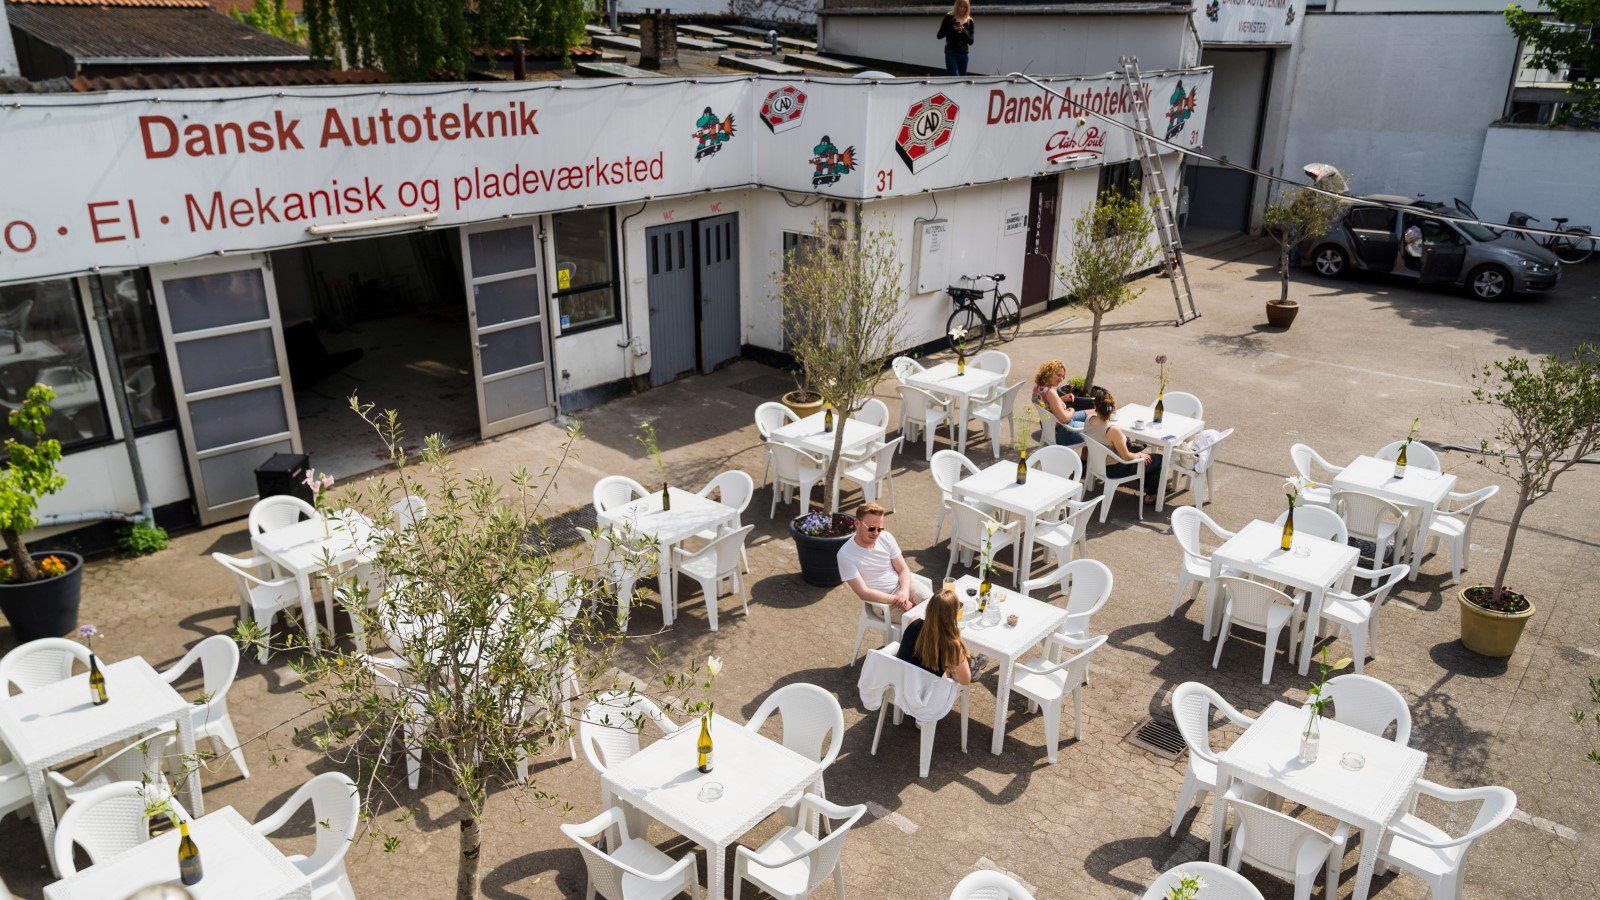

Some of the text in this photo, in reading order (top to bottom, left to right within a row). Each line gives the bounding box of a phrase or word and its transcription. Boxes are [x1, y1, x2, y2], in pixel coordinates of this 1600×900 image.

[987, 88, 1054, 125] Dansk
[139, 101, 539, 159] Dansk Autoteknik
[917, 112, 939, 136] CAD
[877, 169, 893, 192] 31
[88, 199, 140, 243] El
[185, 177, 387, 232] Mekanisk
[398, 179, 440, 213] og
[454, 151, 664, 210] pladeværksted
[710, 202, 722, 214] WC
[663, 209, 674, 221] WC
